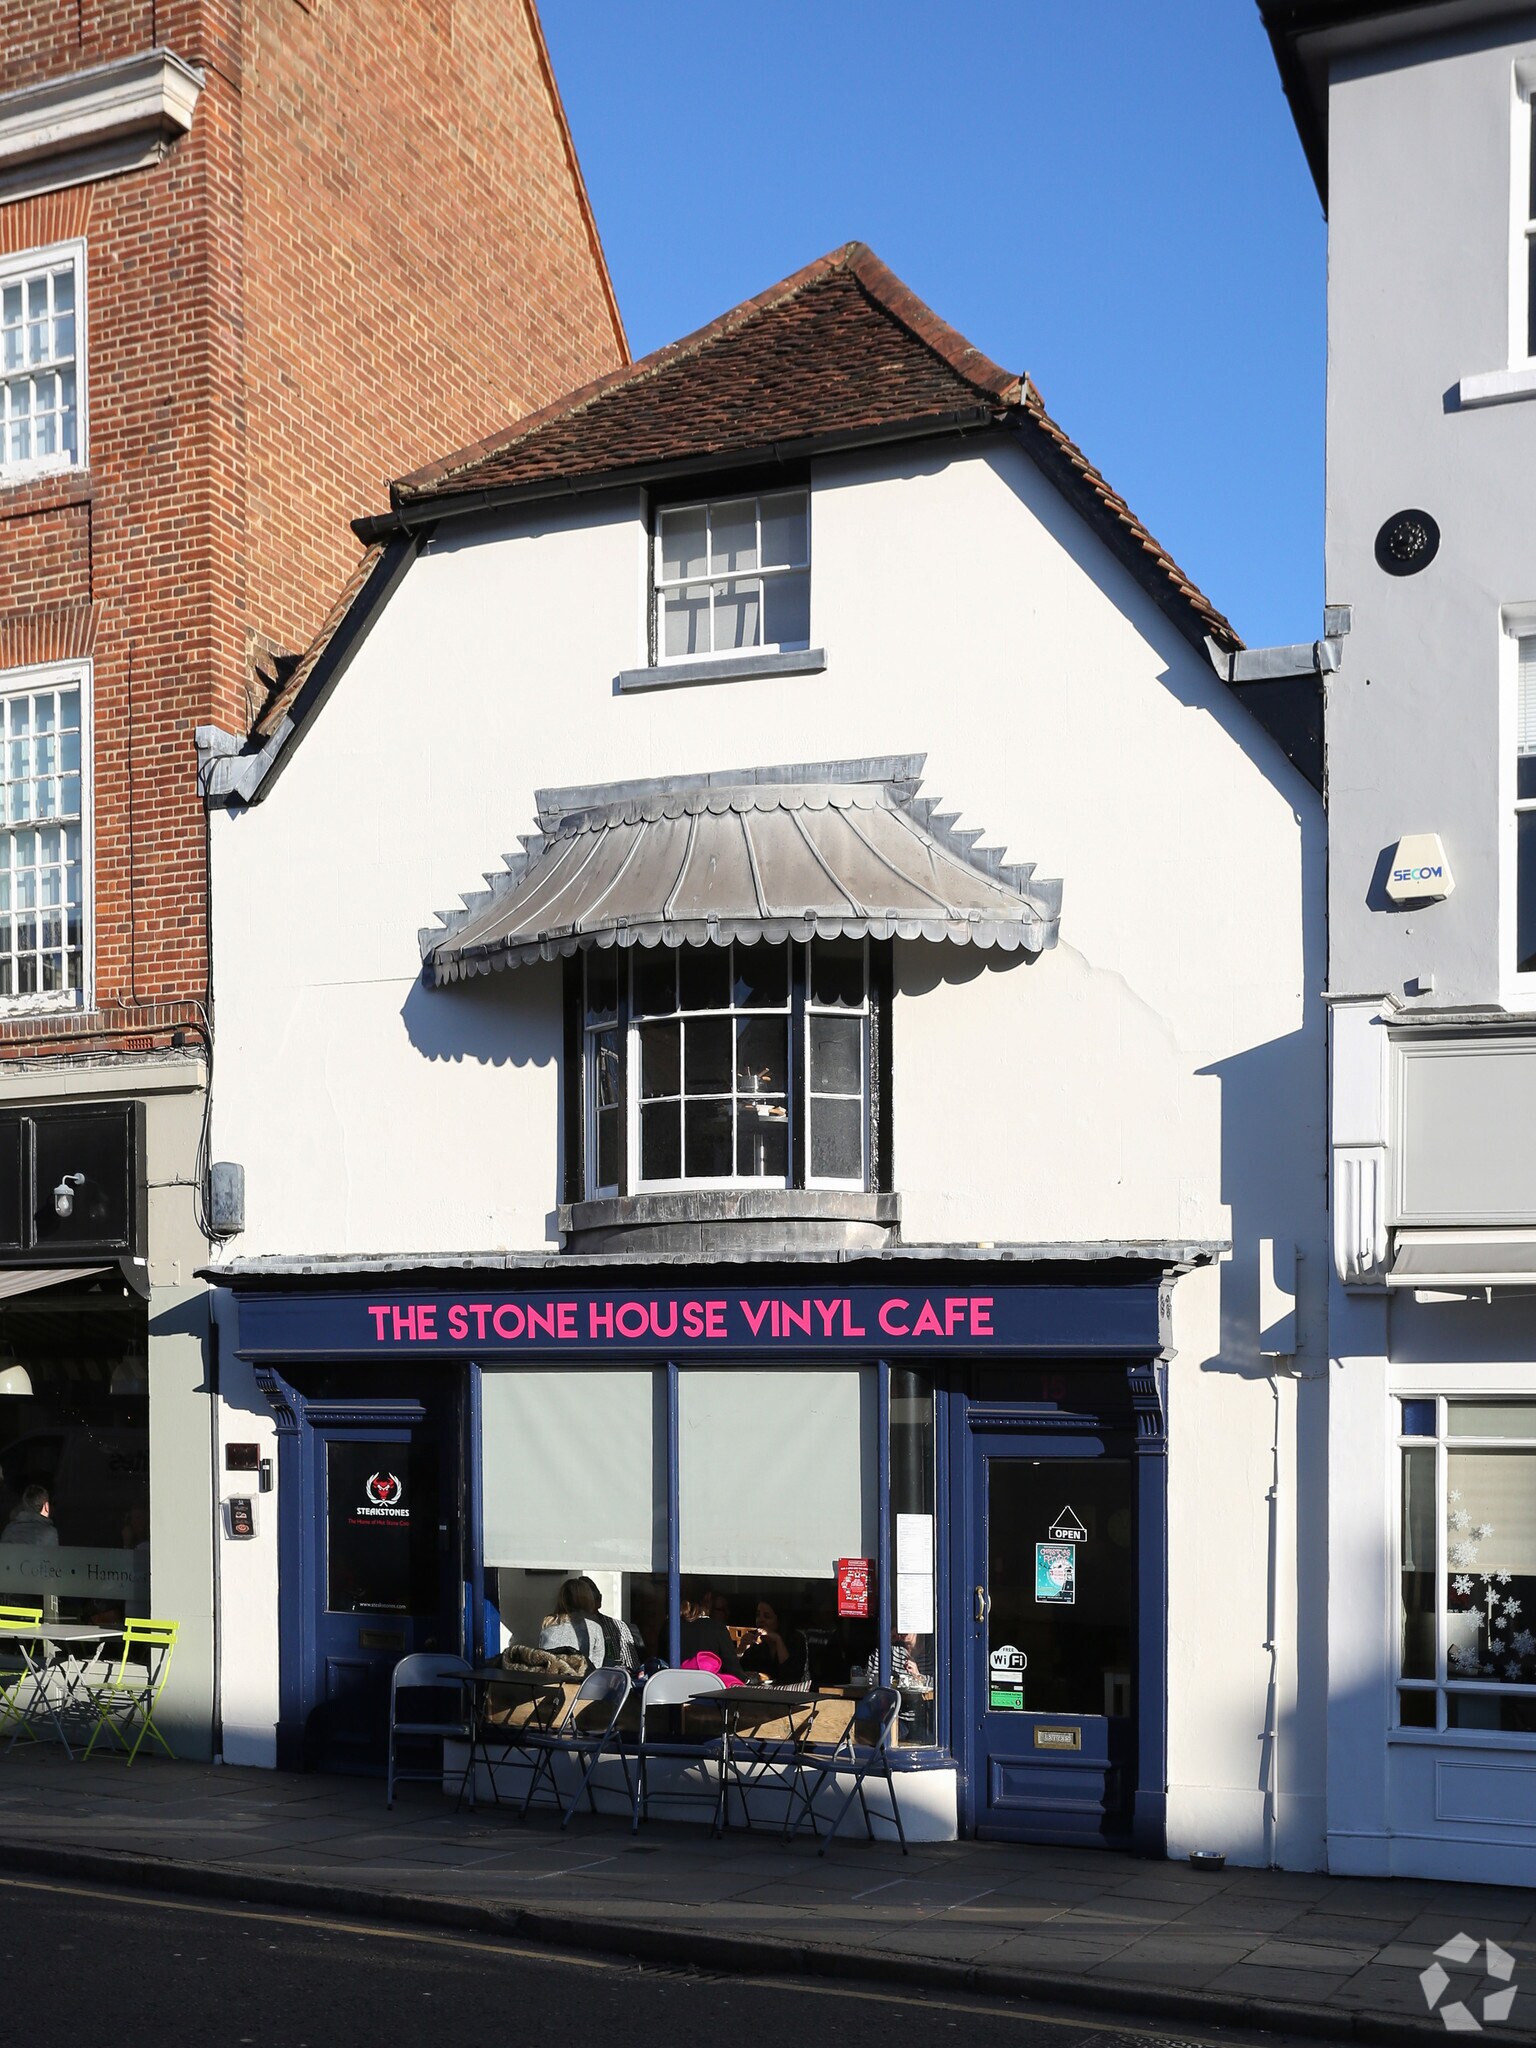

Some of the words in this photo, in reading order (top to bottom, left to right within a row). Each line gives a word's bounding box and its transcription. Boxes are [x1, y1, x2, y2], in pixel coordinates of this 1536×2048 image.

[1393, 866, 1442, 881] SECOM
[369, 1305, 438, 1341] THE
[449, 1303, 578, 1340] STONE
[590, 1301, 728, 1339] HOUSE
[740, 1299, 866, 1337] VINYL
[878, 1297, 994, 1336] CAFE
[1040, 1375, 1067, 1401] 15
[356, 1506, 410, 1517] STEAKSTONES
[1055, 1529, 1081, 1540] OPEN
[20, 1559, 63, 1579] Coffee
